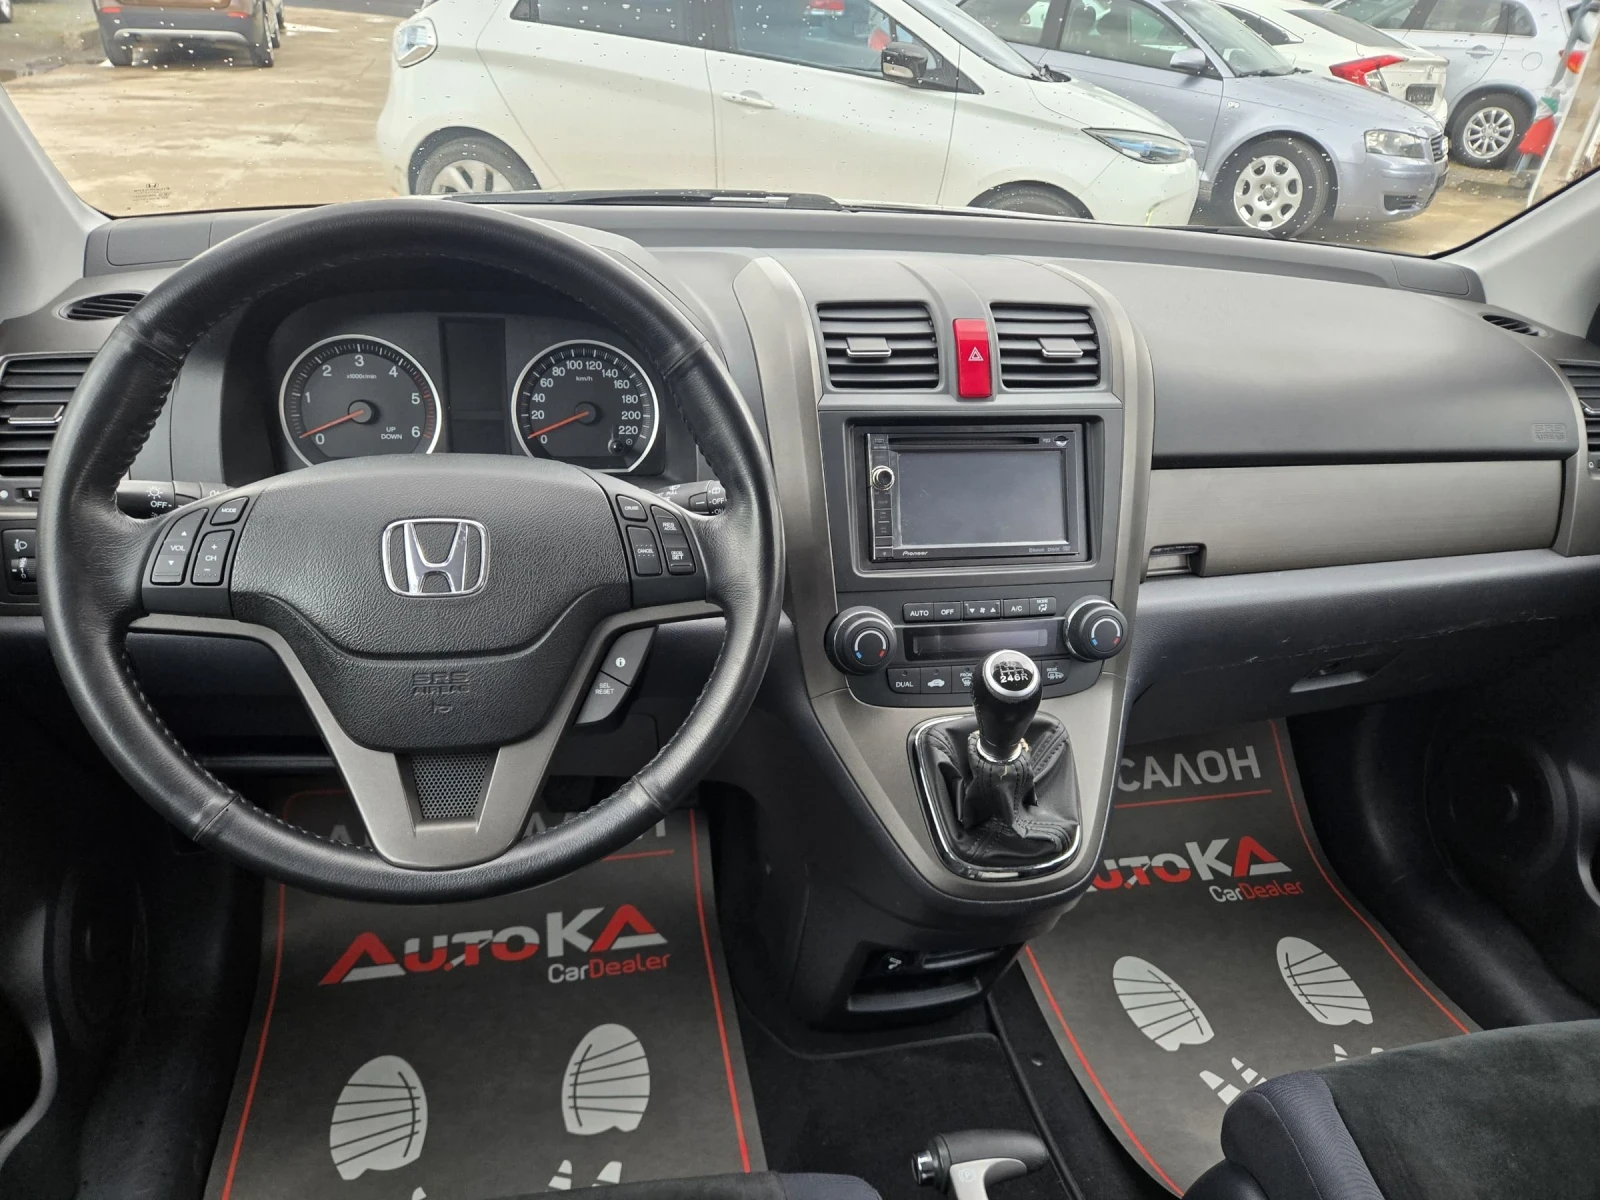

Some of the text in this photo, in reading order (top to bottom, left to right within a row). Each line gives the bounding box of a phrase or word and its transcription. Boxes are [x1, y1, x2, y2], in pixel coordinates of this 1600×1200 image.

[355, 355, 364, 367] 3
[566, 360, 583, 370] 100
[586, 361, 602, 370] 120
[322, 365, 332, 376] 2
[388, 366, 398, 377] 4
[552, 367, 565, 376] 80
[602, 369, 618, 378] 140
[540, 378, 553, 388] 60
[614, 380, 630, 389] 160
[304, 392, 311, 403] 1
[411, 393, 420, 404] 5
[532, 393, 545, 403] 40
[622, 395, 638, 404] 180
[531, 410, 544, 420] 20
[621, 411, 641, 420] 200
[411, 426, 420, 437] 6
[619, 426, 638, 435] 220
[315, 434, 325, 445] 0
[540, 435, 547, 444] 0
[413, 672, 470, 684] SRS
[1086, 836, 1292, 893] UTOKA
[1209, 880, 1304, 902] CarDealer
[547, 953, 671, 983] CarDealer
